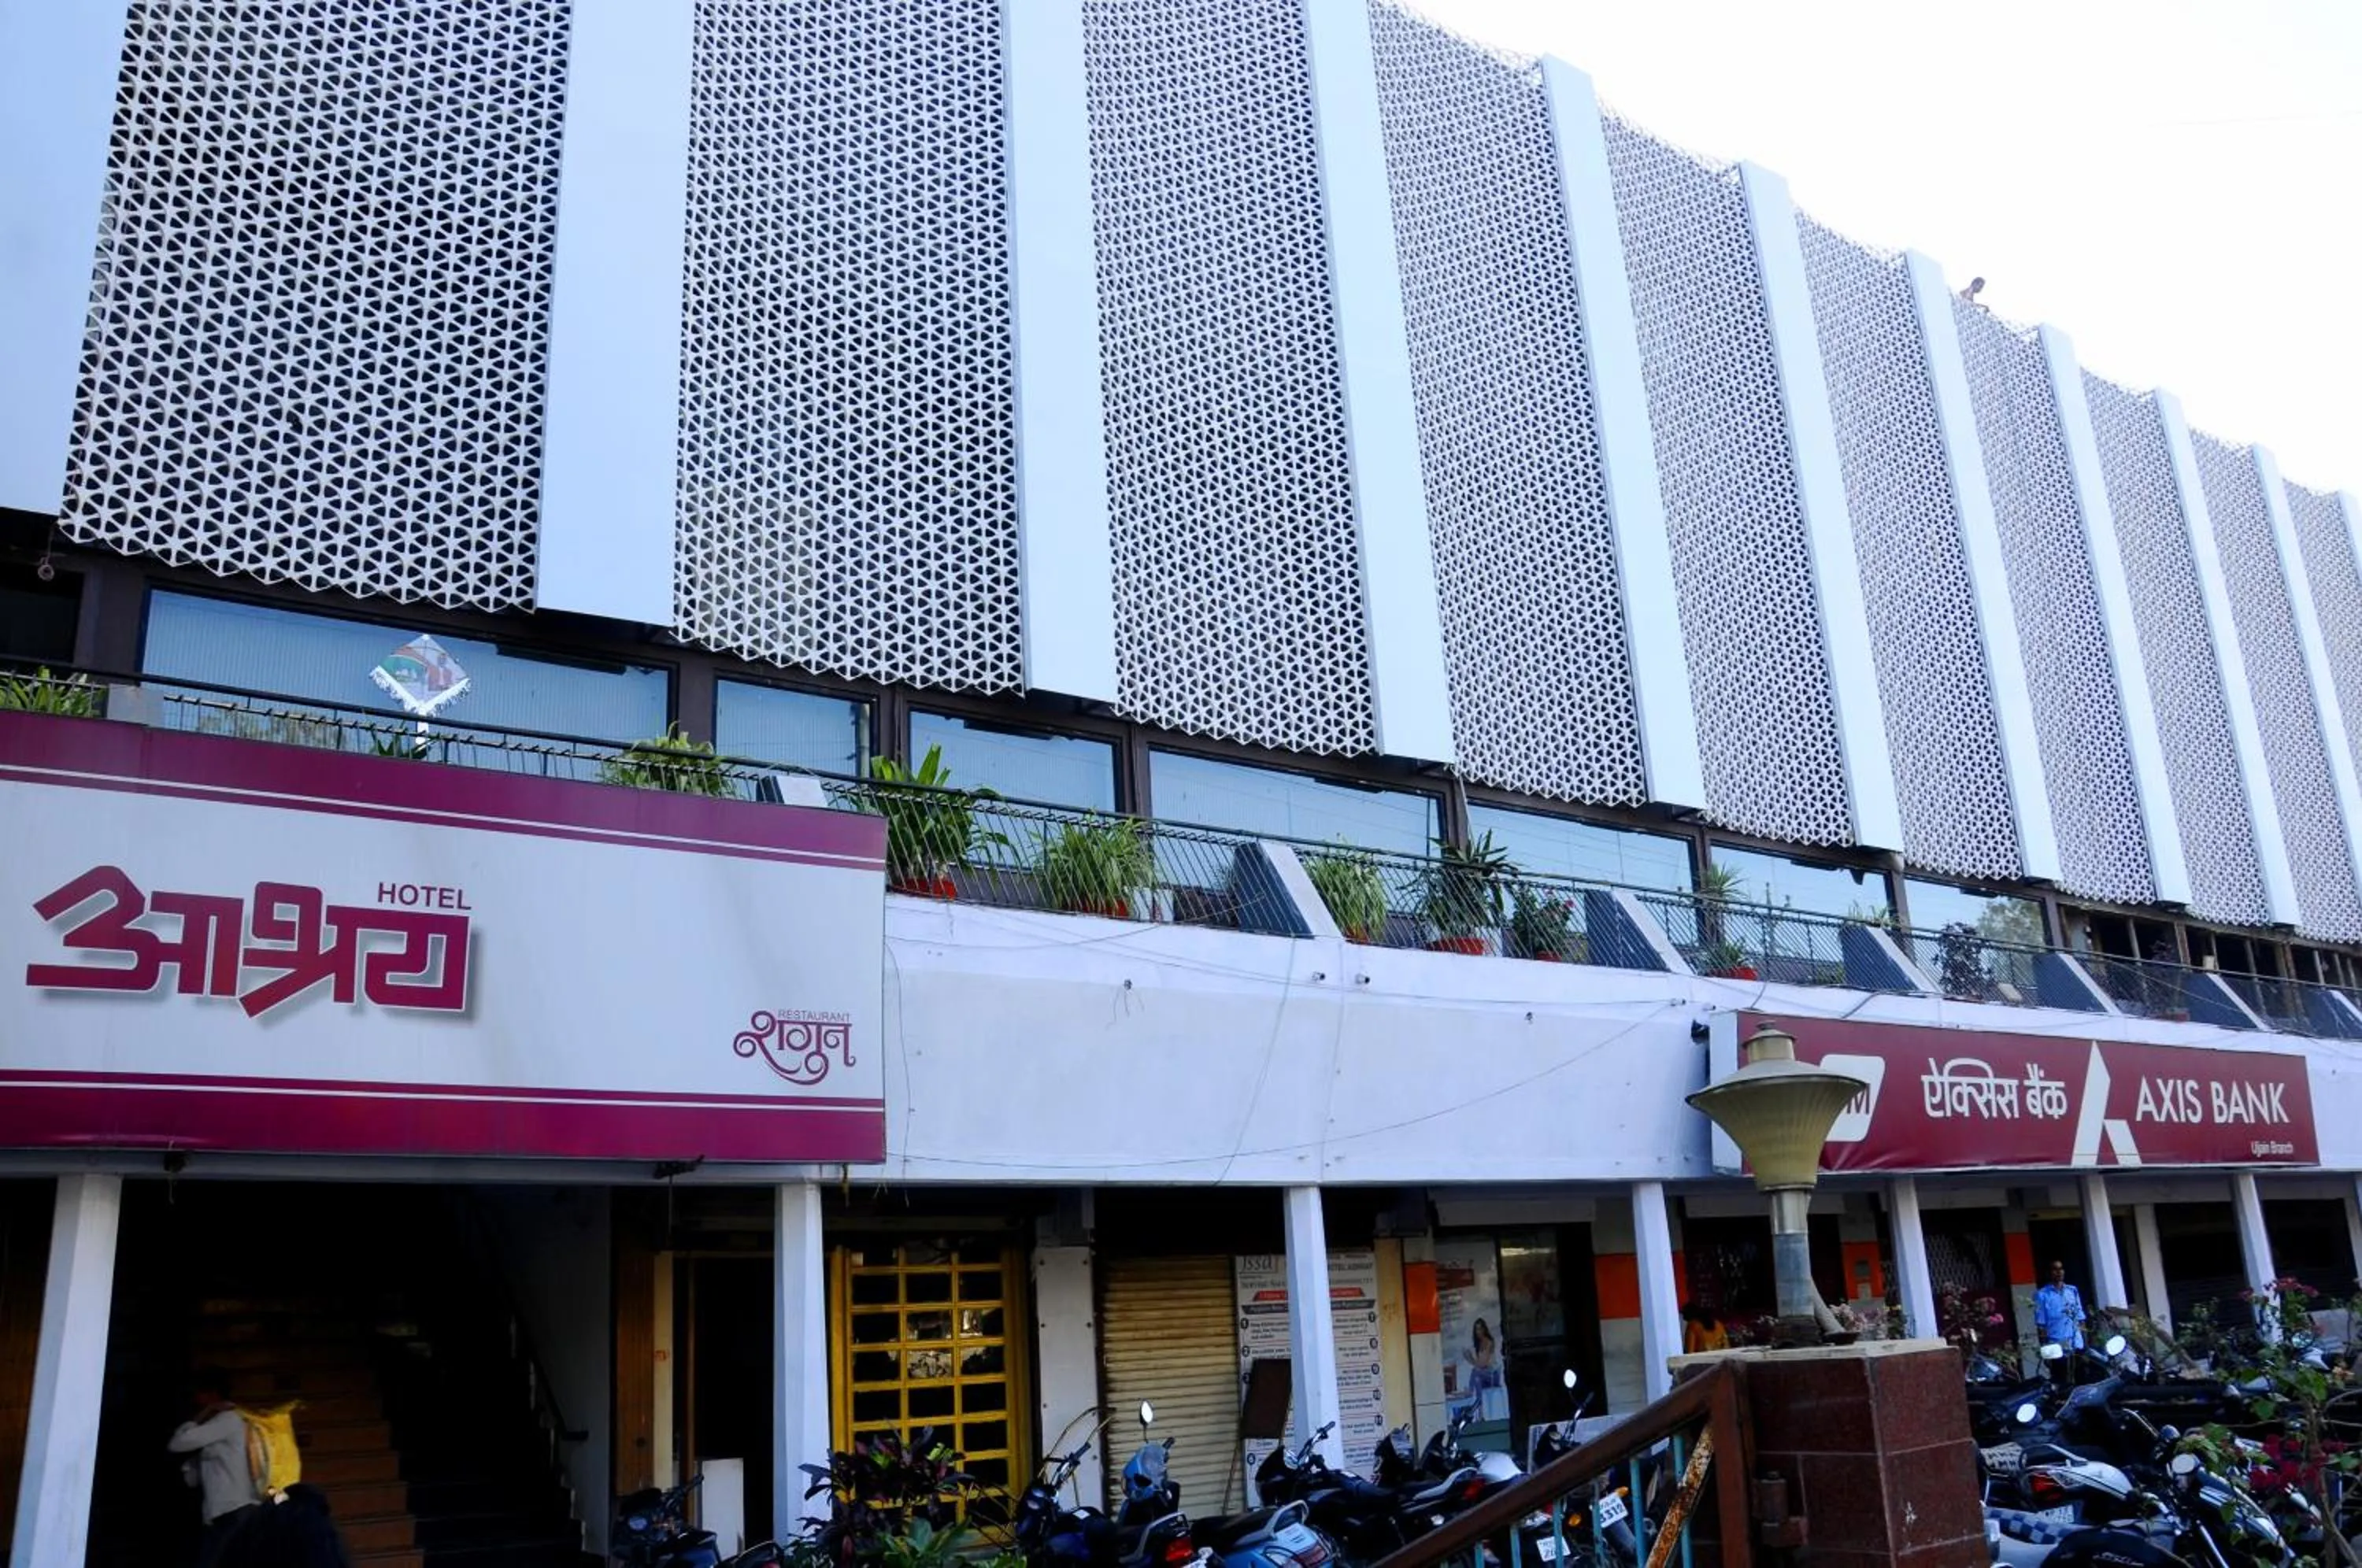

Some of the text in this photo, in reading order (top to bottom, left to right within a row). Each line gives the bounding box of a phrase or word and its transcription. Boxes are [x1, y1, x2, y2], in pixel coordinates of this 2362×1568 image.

[378, 882, 472, 911] HOTEL
[27, 865, 471, 1018] आश्रय
[778, 1009, 850, 1023] RESTAURANT
[733, 1011, 857, 1085] शगुन
[2023, 1063, 2068, 1119] बैंक
[2135, 1076, 2290, 1125] AXIS BANK
[2271, 1141, 2294, 1155] Branch
